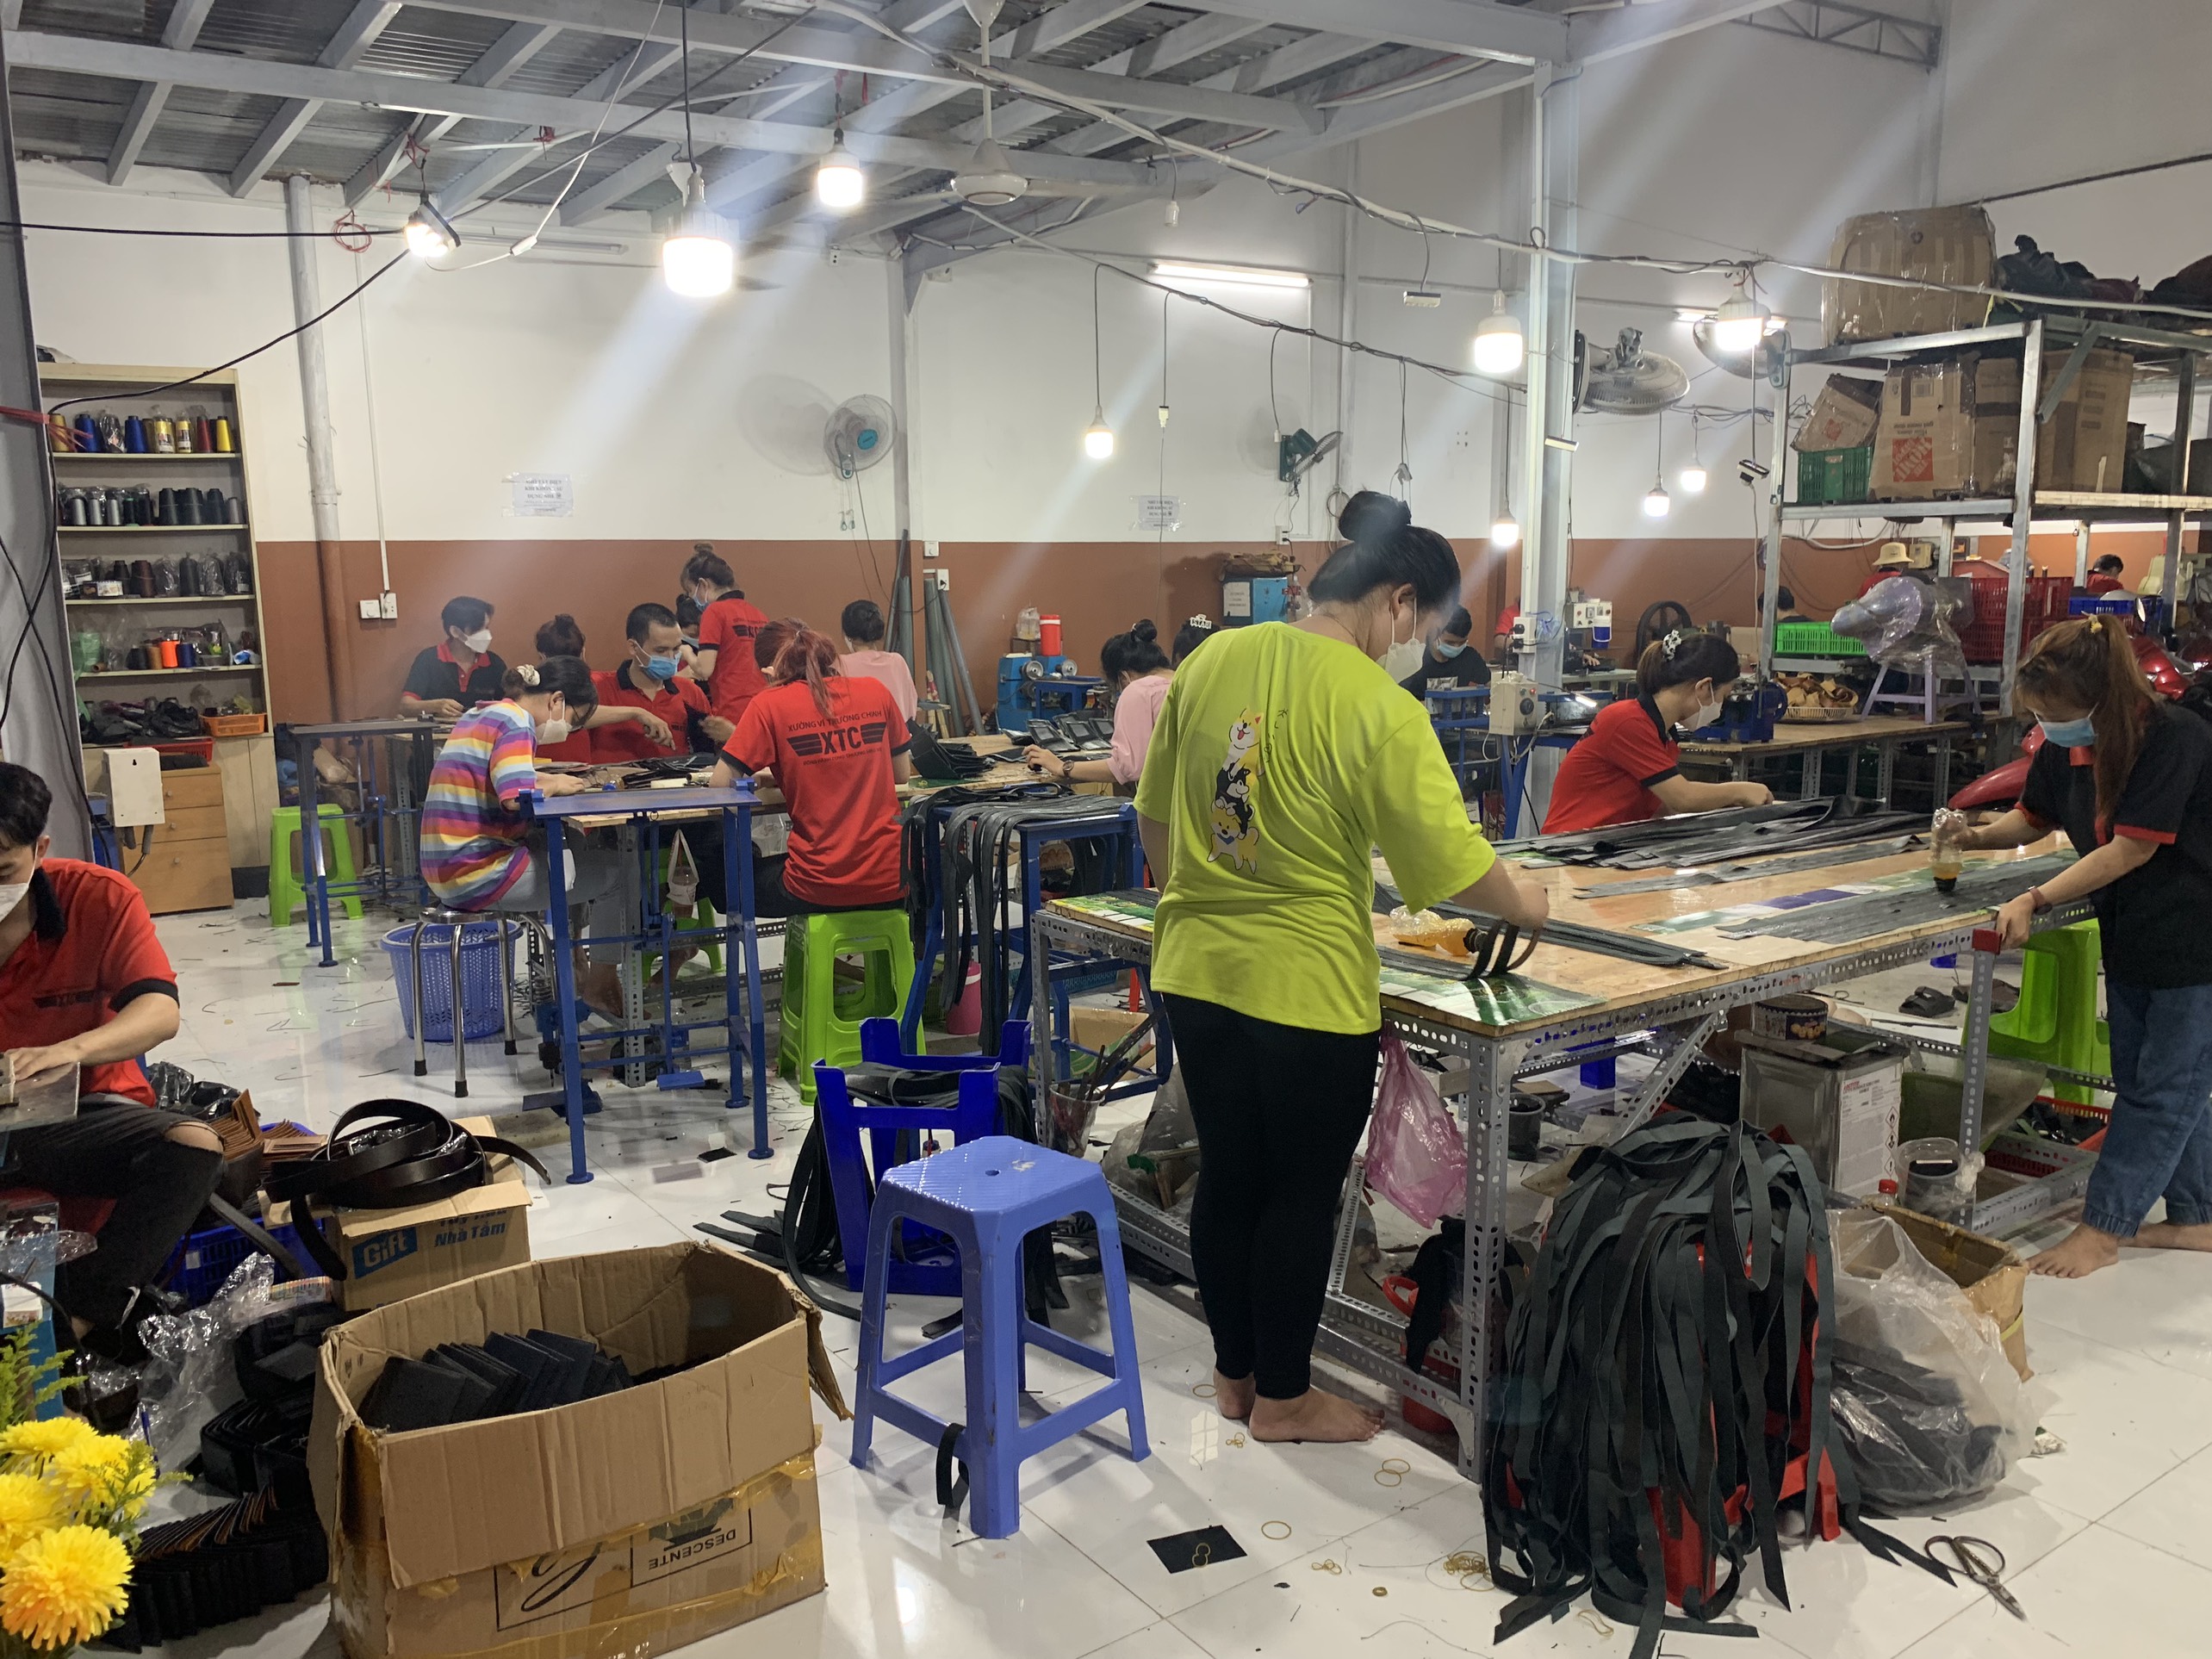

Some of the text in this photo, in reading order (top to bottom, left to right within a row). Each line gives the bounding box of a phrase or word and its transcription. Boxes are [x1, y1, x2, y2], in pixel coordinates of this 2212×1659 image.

[820, 726, 861, 755] XTC
[363, 1232, 409, 1268] Gift
[434, 1227, 468, 1248] Nhà
[648, 1528, 736, 1570] DESCENTE
